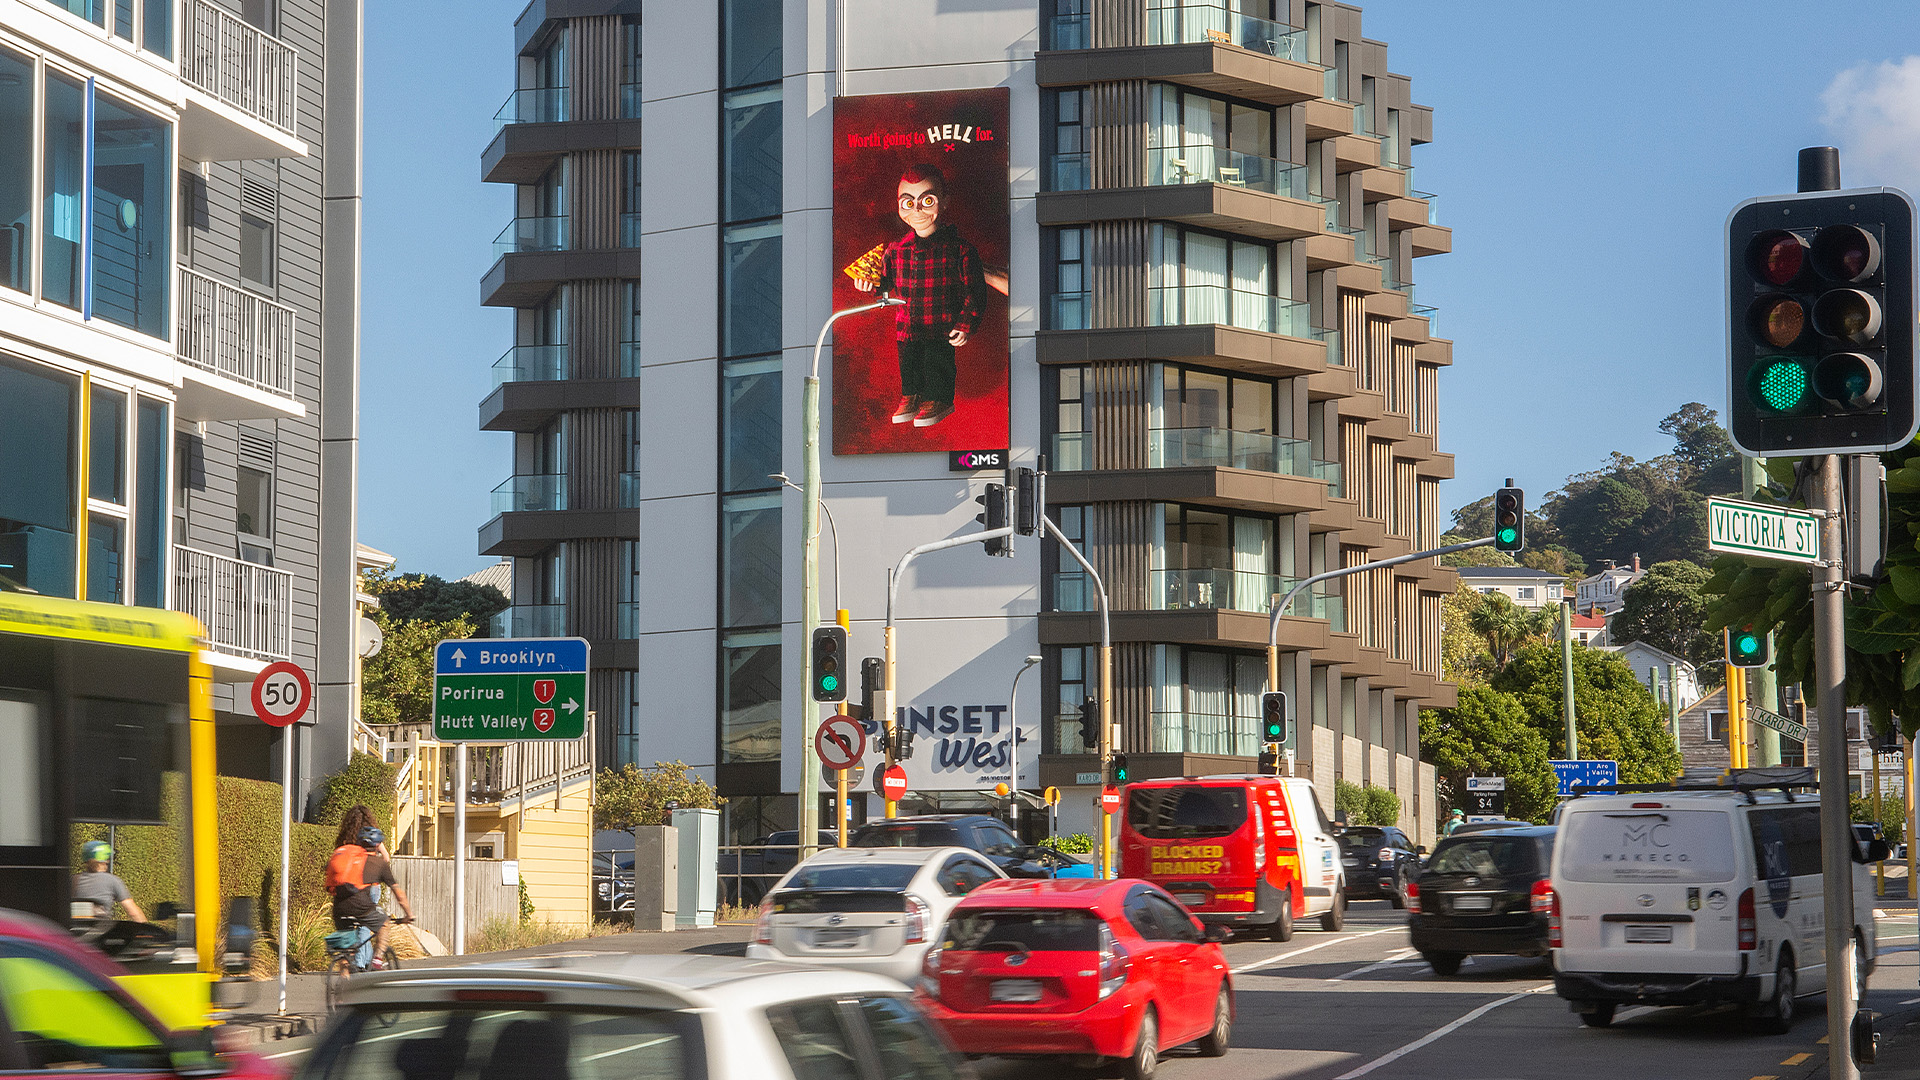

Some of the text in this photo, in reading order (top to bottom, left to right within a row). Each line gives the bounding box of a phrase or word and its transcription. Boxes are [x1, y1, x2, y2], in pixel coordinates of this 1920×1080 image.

[848, 123, 994, 150] Worth going to HELL for.
[1715, 508, 1812, 552] VICTORIA ST
[480, 650, 556, 667] Brooklyn
[265, 682, 297, 705] 50
[441, 683, 547, 700] Porirua 1
[441, 712, 549, 731] Hutt Valley 2
[1758, 711, 1801, 737] KARO DR
[1592, 769, 1614, 777] Valley
[1623, 823, 1671, 848] MC
[1151, 845, 1224, 859] BLOCKED
[1151, 861, 1223, 875] DRAINS?
